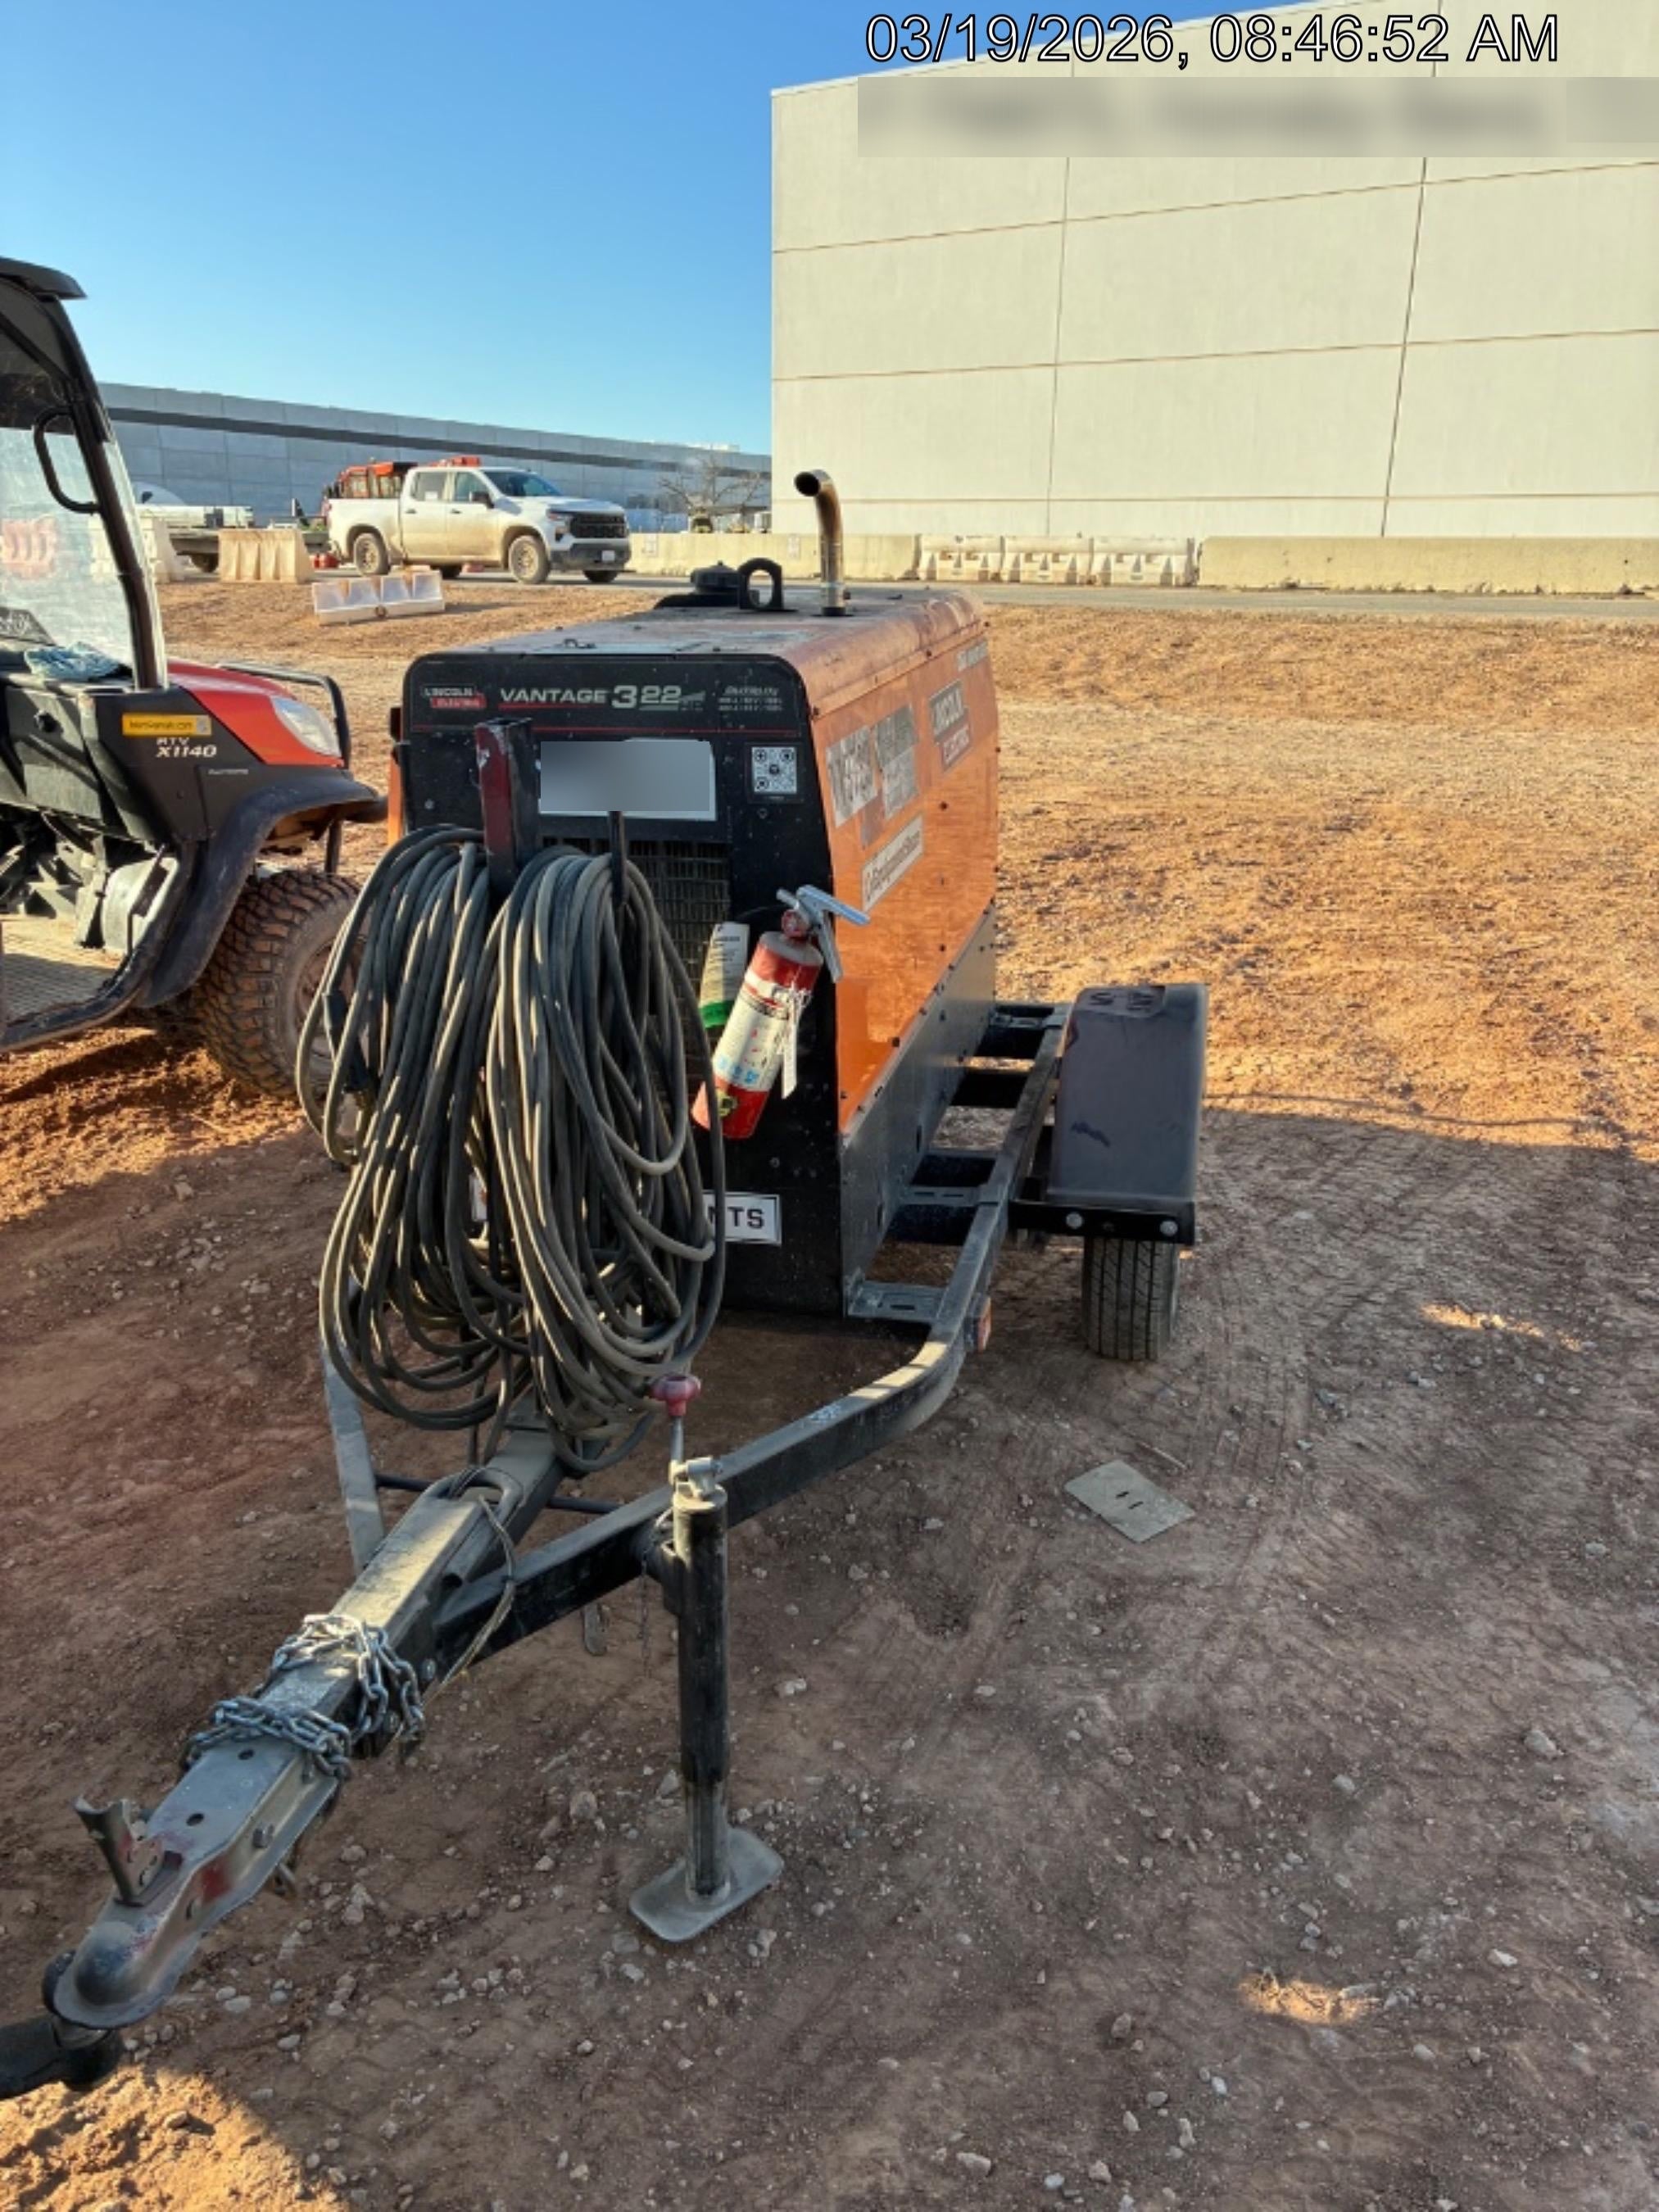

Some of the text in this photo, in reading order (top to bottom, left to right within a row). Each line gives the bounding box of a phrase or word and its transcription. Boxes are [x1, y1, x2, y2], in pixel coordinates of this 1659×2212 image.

[501, 688, 608, 703] VANTAGE
[611, 685, 682, 709] 322
[156, 745, 217, 758] X1140
